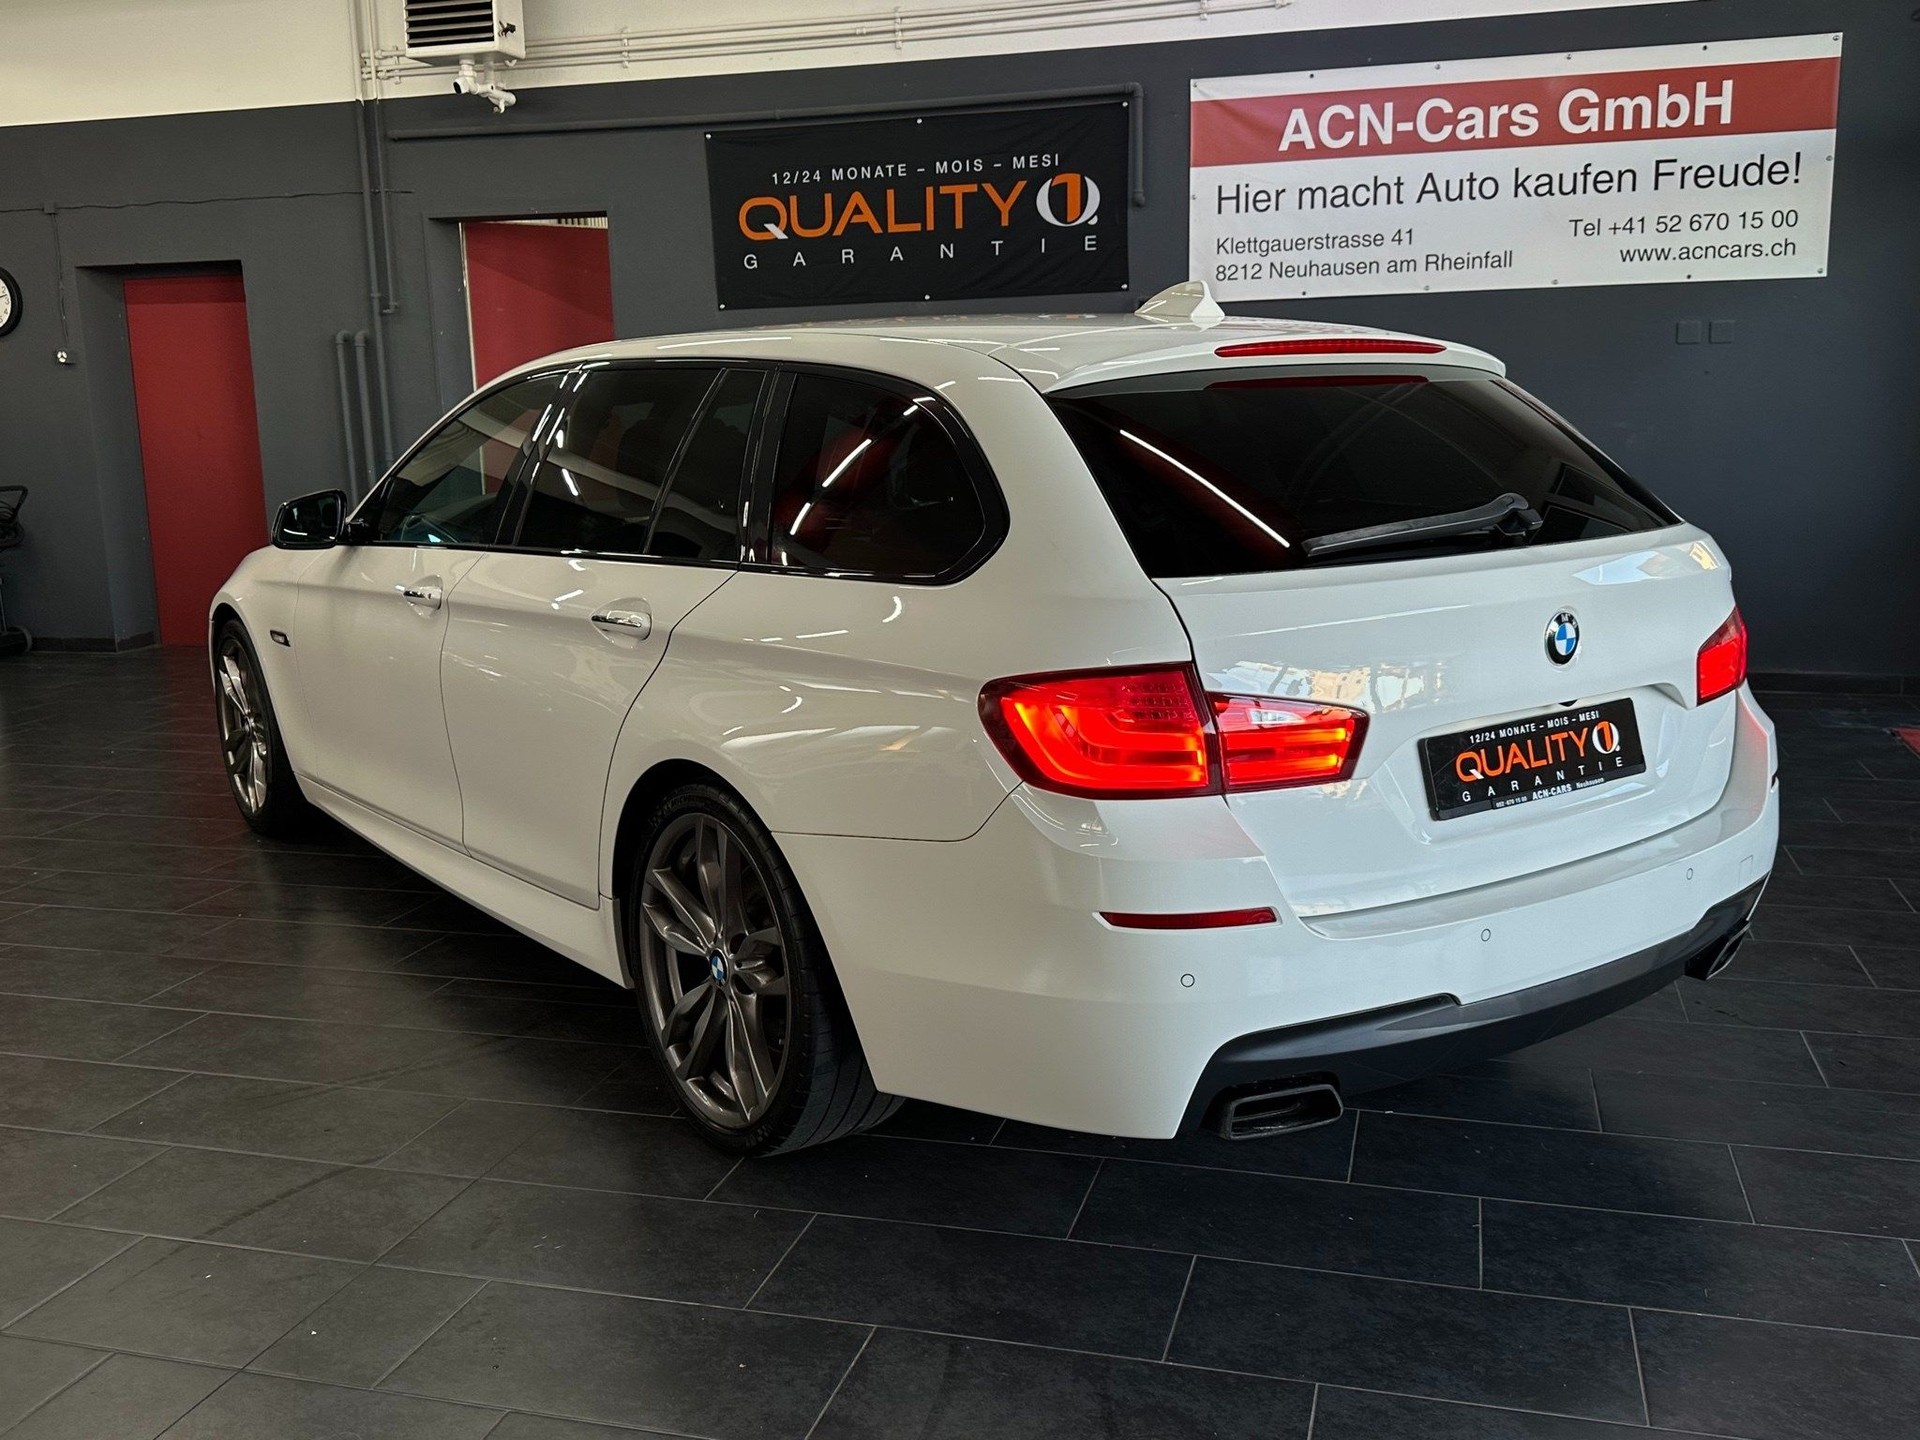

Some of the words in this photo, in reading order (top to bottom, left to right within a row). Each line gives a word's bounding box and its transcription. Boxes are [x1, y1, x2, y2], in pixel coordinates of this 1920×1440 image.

[1278, 98, 1539, 152] ACN-Cars
[1558, 79, 1734, 134] GmbH
[772, 169, 821, 185] 12/24
[831, 163, 907, 181] MONATE
[935, 158, 983, 174] MOIS
[1012, 153, 1059, 169] MESI
[1216, 182, 1286, 215] Hier
[1297, 175, 1405, 210] macht
[1416, 171, 1499, 204] Auto
[1513, 162, 1637, 199] kaufen
[1653, 151, 1802, 191] Freude!
[738, 180, 1027, 241] QUALITY
[1568, 218, 1601, 237] Tel
[1608, 216, 1647, 236] +41
[1655, 214, 1682, 234] 52
[1689, 212, 1730, 232] 670
[1739, 210, 1765, 230] 15
[1771, 209, 1799, 229] 00
[743, 235, 1097, 270] GARANTIE
[1216, 232, 1385, 258] Klettgauerstrasse
[1391, 228, 1414, 247] 41
[1619, 237, 1797, 264] www.acncars.ch
[1215, 262, 1264, 282] 8212
[1269, 258, 1380, 279] Neuhausen
[1386, 258, 1417, 274] am
[1425, 250, 1513, 273] Rheinfall
[1469, 731, 1496, 744] 12/24
[1499, 722, 1537, 738] MONATE
[1547, 717, 1569, 729] MOIS
[1579, 710, 1600, 722] MESI
[1455, 728, 1588, 782] QUALITY
[1462, 756, 1624, 802] GARANTIE
[1531, 783, 1573, 801] ACN-CARS
